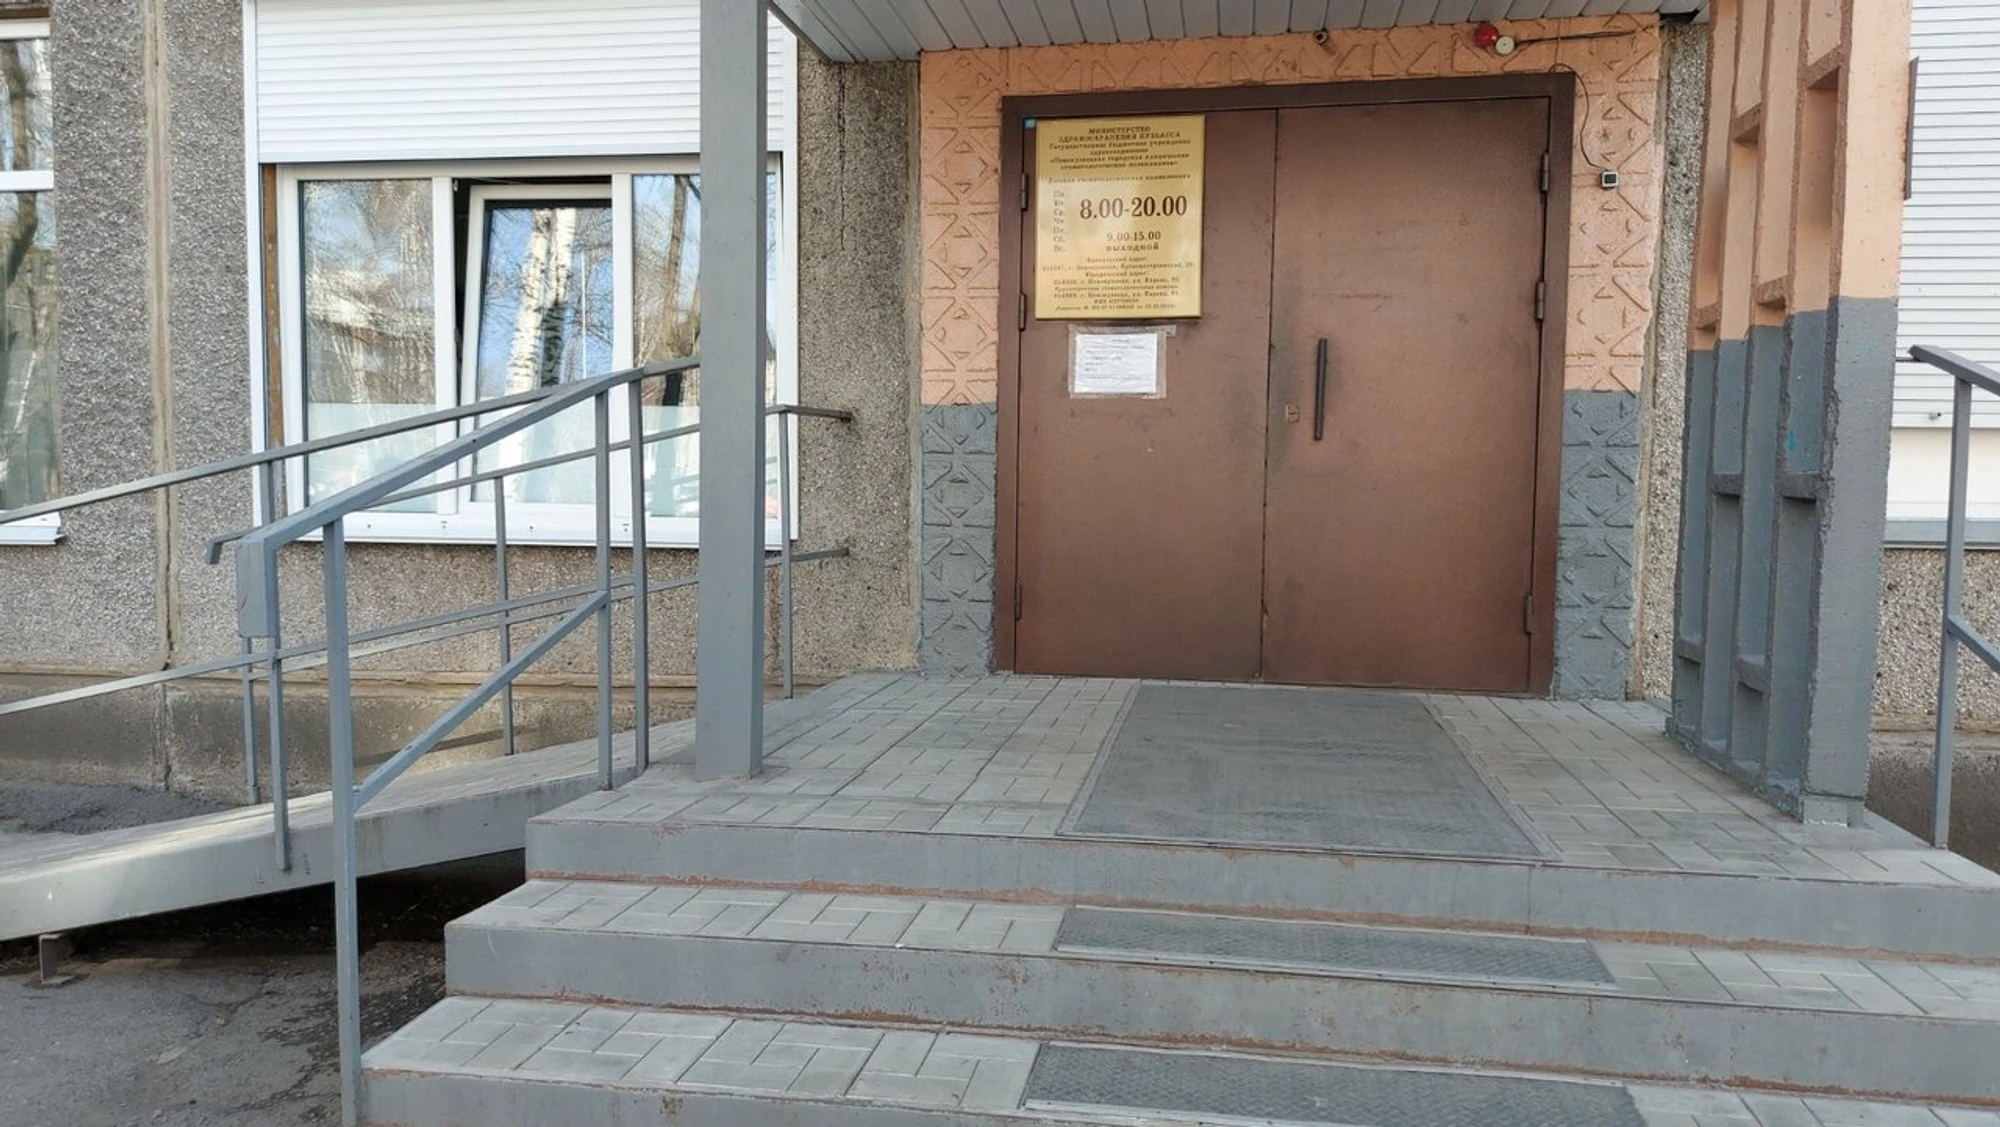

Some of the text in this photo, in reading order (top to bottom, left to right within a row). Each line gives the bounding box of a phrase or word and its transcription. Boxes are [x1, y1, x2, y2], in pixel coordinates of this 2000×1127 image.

[1088, 126, 1151, 134] МИНИСТЕРСТВО
[1080, 195, 1188, 220] 8.00-20.00
[1106, 242, 1159, 252] выходной
